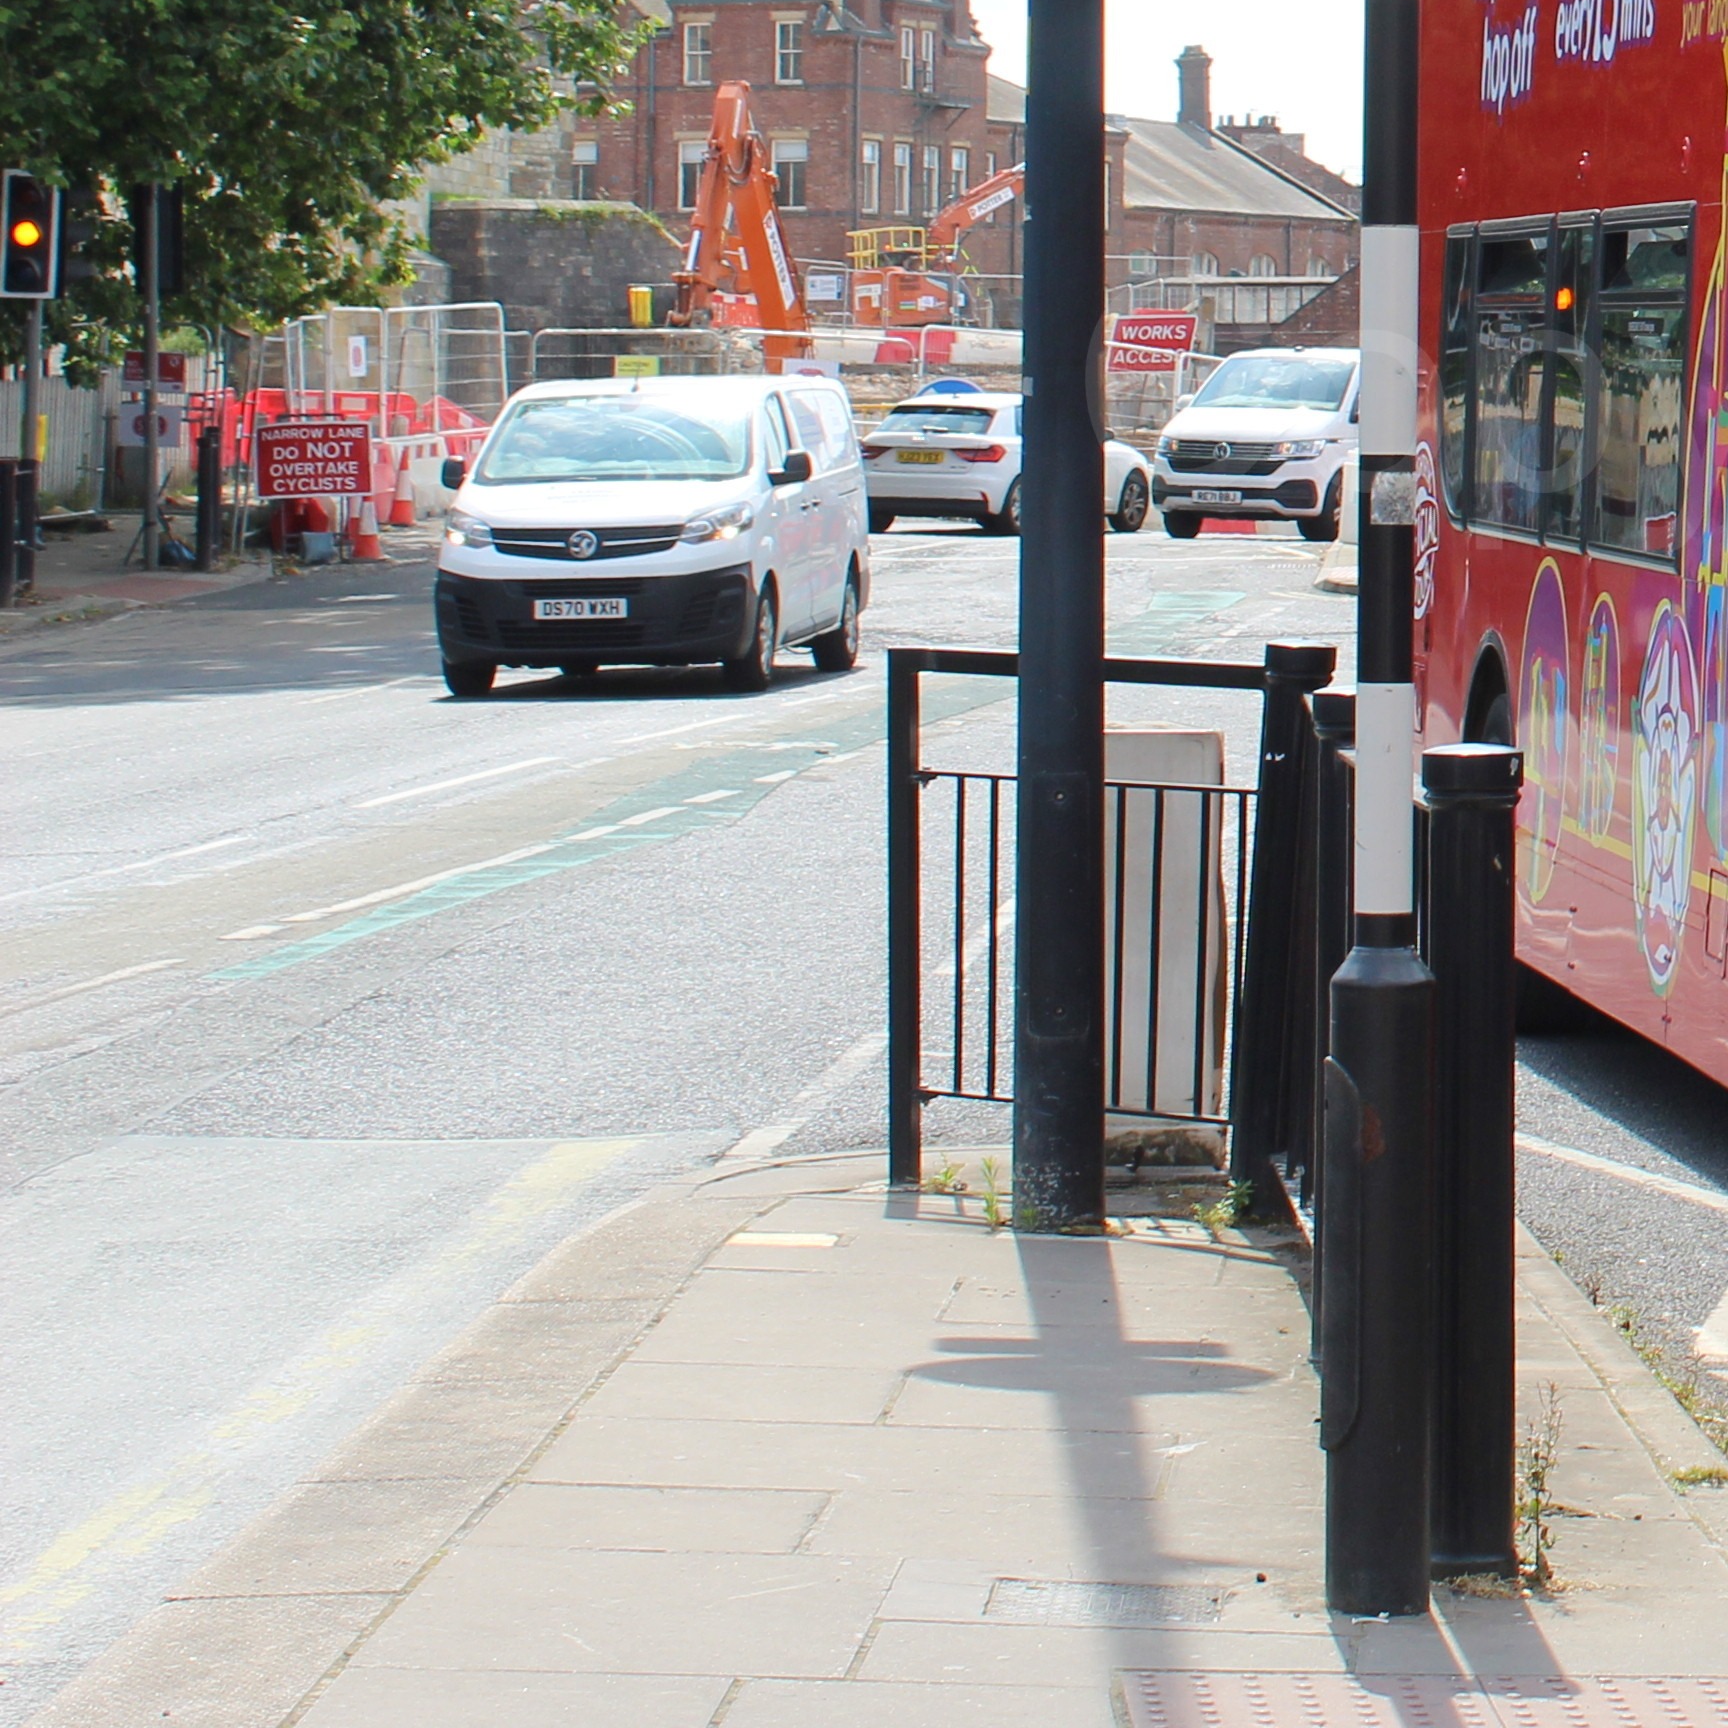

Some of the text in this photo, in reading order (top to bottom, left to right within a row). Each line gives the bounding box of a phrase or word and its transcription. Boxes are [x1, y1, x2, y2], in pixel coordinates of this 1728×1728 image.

[1480, 5, 1537, 116] hop off
[1122, 324, 1187, 341] WORKS
[1113, 349, 1186, 364] ACCES
[261, 427, 364, 441] NARROW LANE
[272, 441, 354, 460] DO NOT
[269, 461, 359, 477] OVERTAKE
[272, 477, 357, 492] CYCLISTS
[542, 601, 585, 616] DS70
